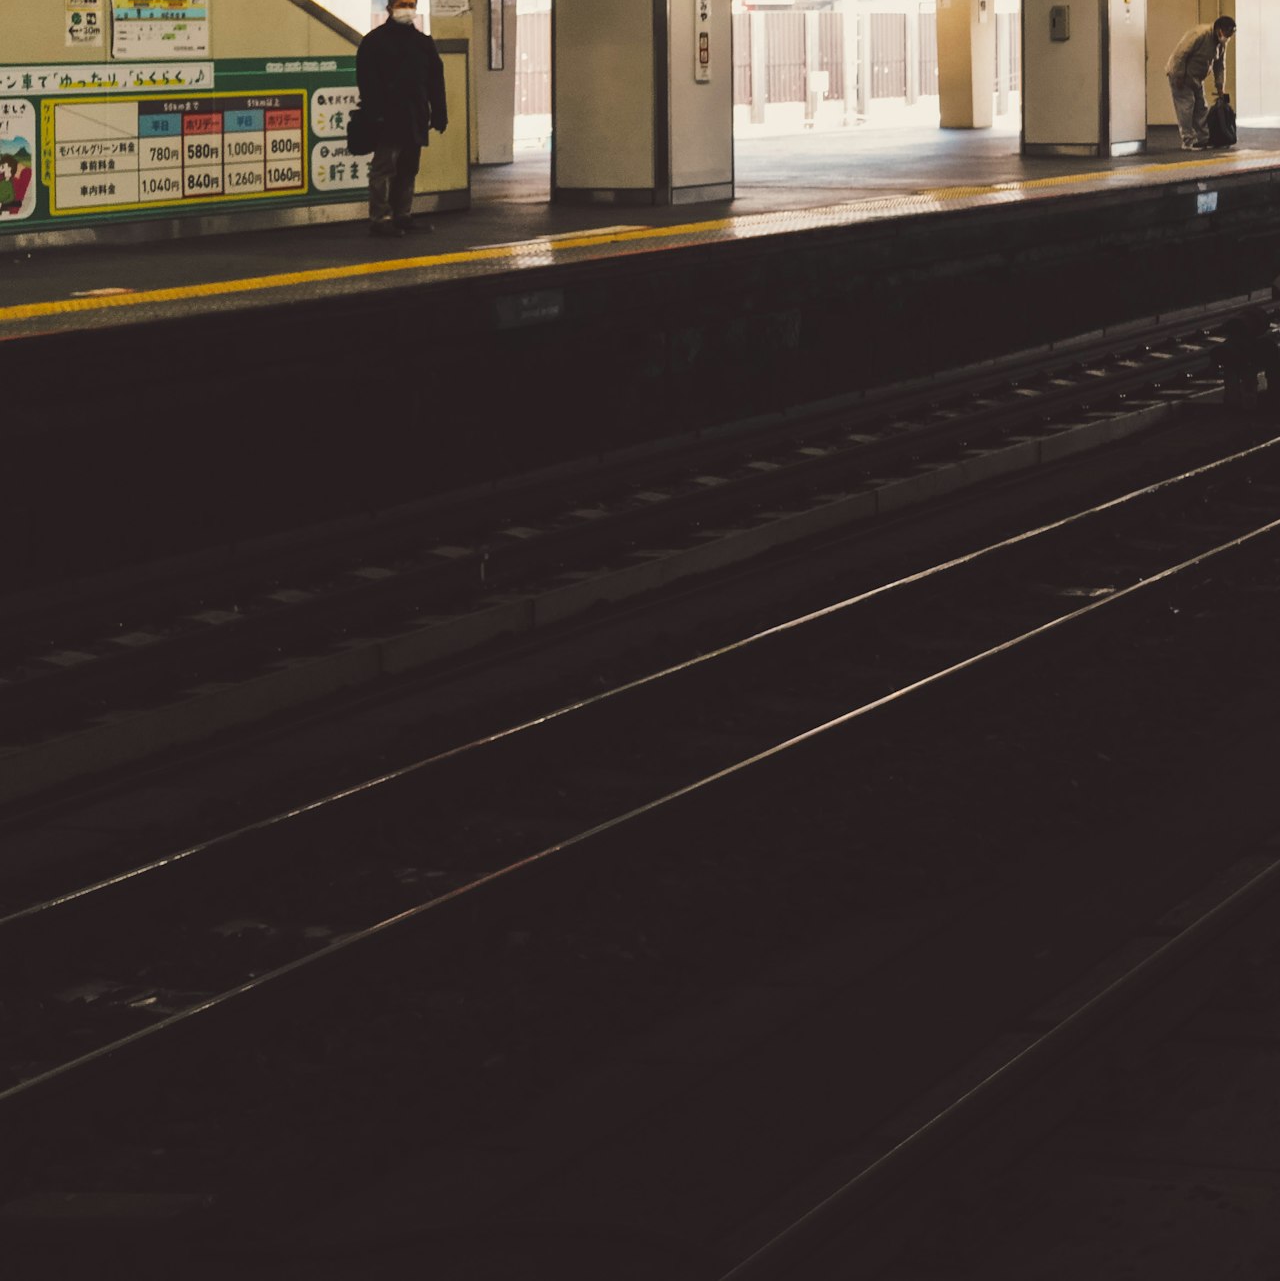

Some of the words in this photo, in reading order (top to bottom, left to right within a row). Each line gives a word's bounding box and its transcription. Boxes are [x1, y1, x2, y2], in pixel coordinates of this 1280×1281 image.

[150, 146, 180, 161] 780円
[187, 144, 219, 160] 580円
[227, 141, 263, 157] 1,000円
[271, 138, 301, 153] 800円
[142, 178, 180, 194] 1,040円
[187, 174, 219, 190] 840円
[227, 171, 262, 188] 1,260円
